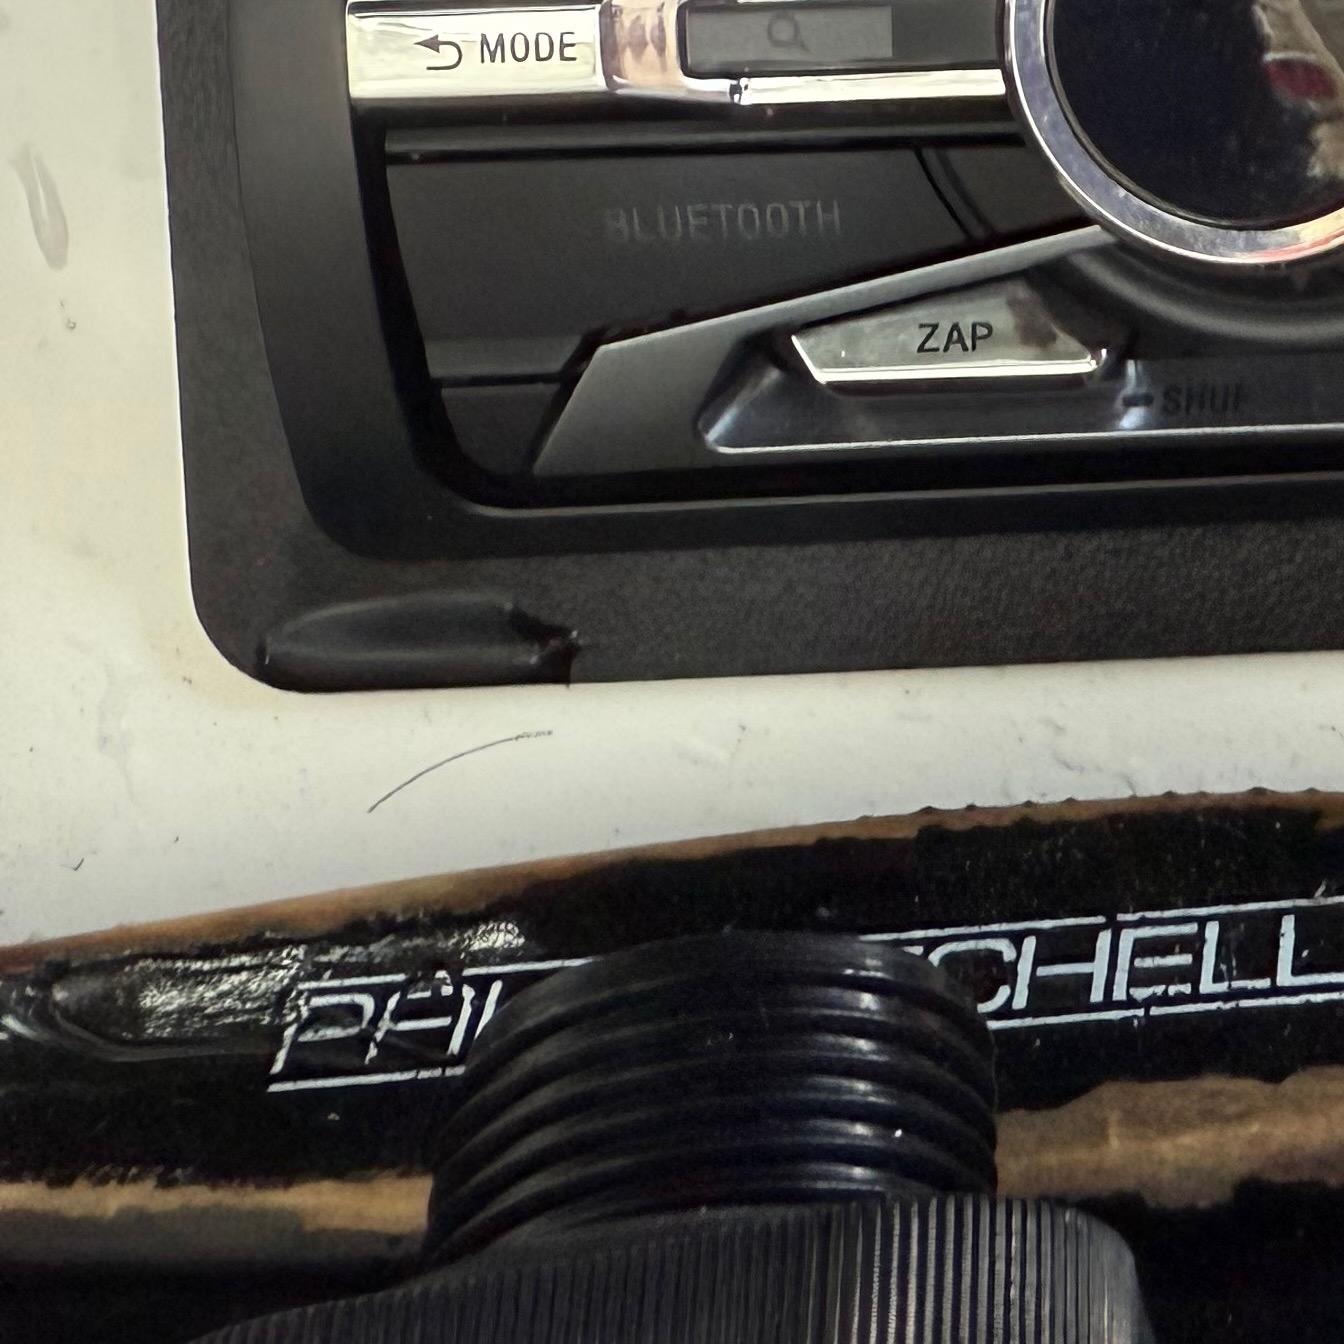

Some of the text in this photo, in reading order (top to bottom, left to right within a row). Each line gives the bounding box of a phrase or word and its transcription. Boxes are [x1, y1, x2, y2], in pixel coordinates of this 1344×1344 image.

[479, 30, 579, 65] MODE
[604, 198, 841, 243] BLUETOOTH
[917, 320, 995, 355] ZAP
